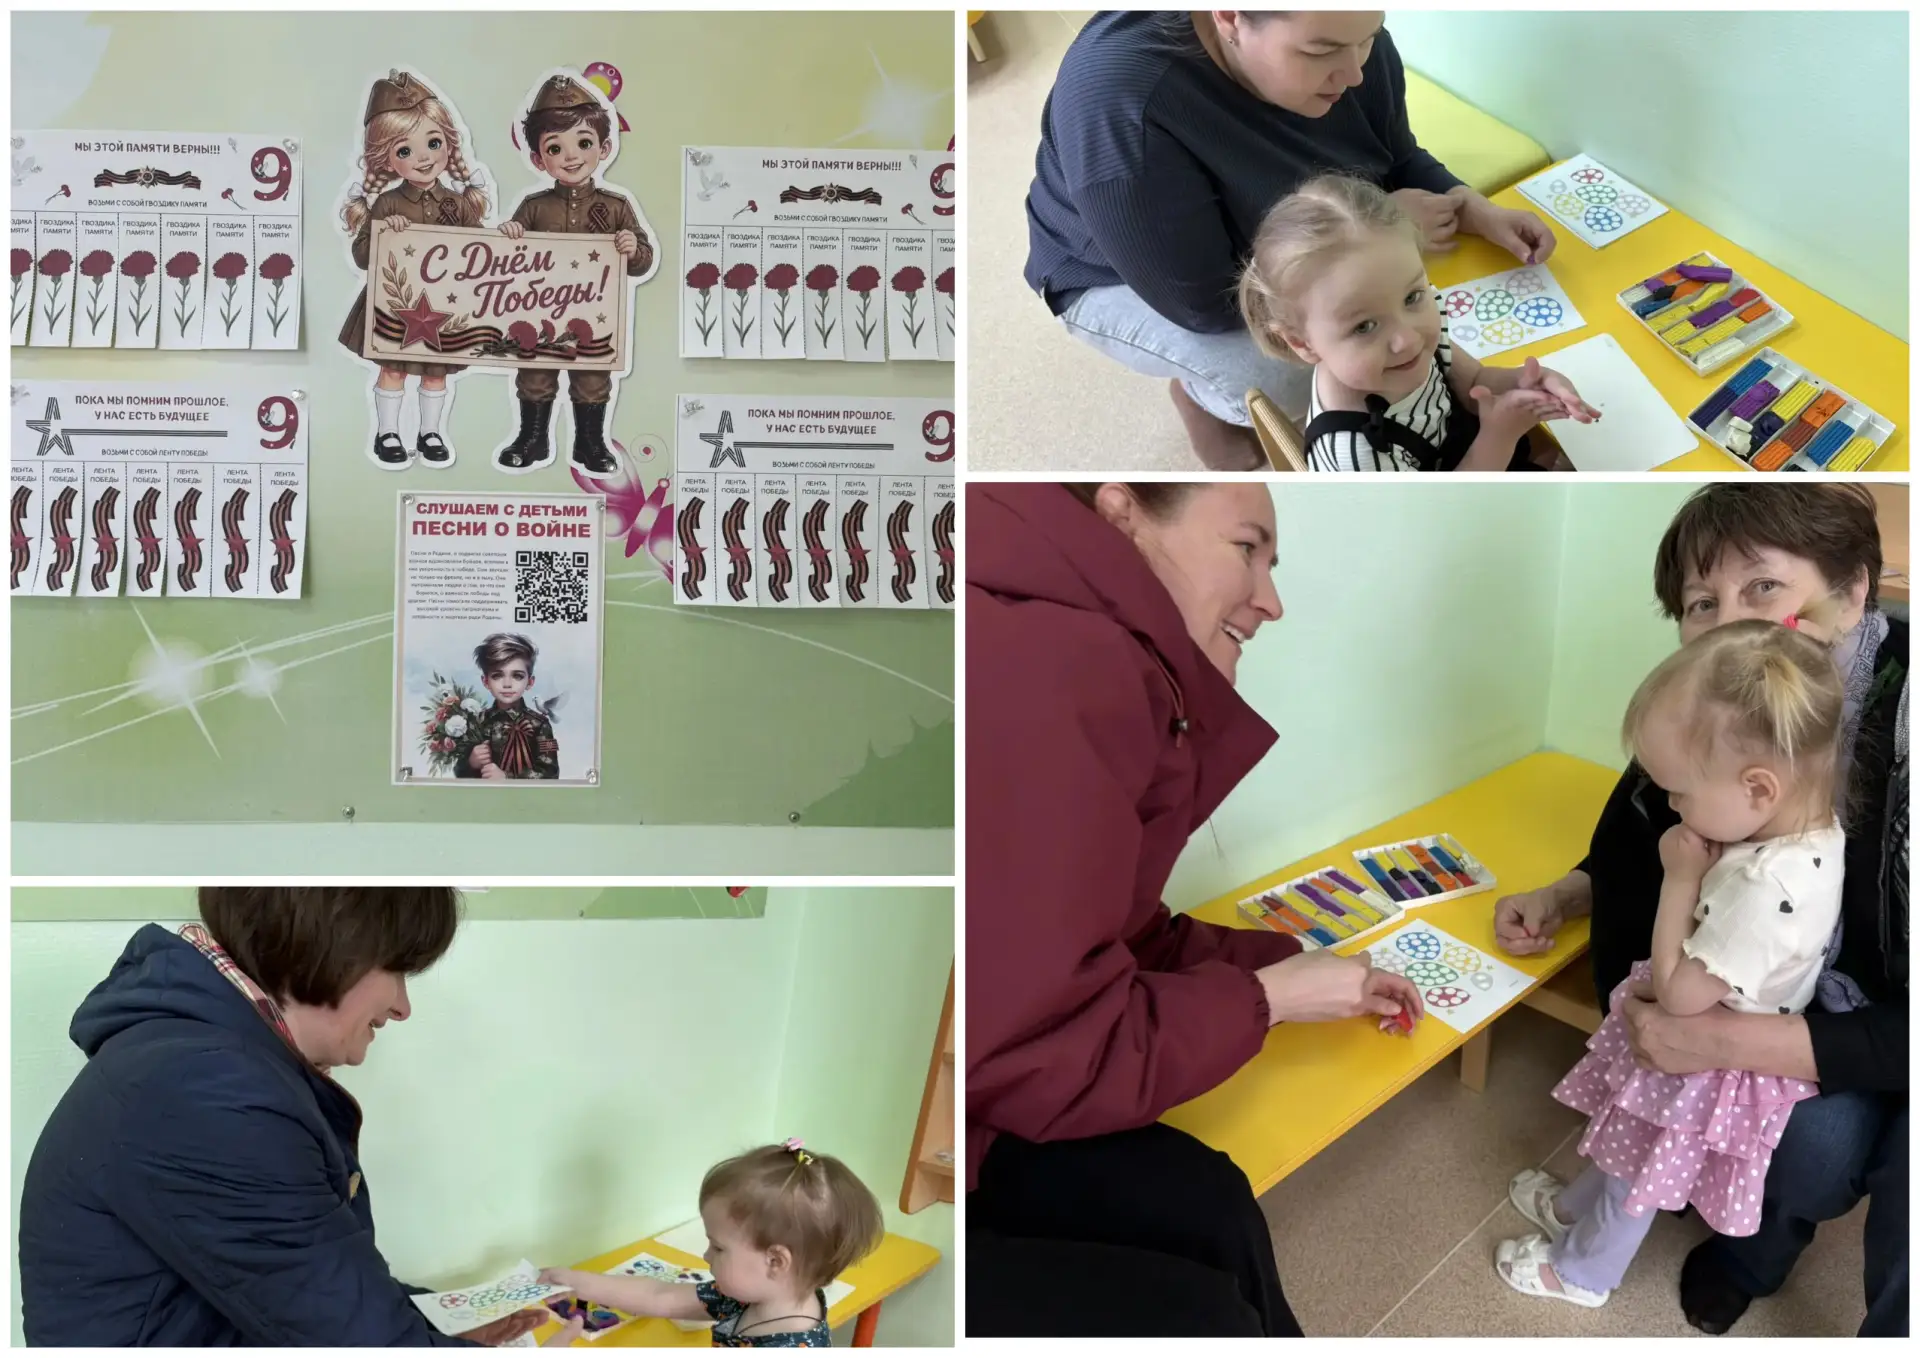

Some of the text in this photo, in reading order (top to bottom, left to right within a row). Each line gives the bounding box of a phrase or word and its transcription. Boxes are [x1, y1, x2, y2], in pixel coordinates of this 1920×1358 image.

[75, 140, 220, 155] МЫ ЭТОЙ ПАМЯТИ ВЕРНЫ!!!
[762, 158, 902, 172] МЫ ЭТОЙ ПАМЯТИ ВЕРНЫ!!!
[250, 146, 292, 201] 9
[88, 199, 115, 207] ВОЗЬМИ
[122, 198, 145, 207] СОБОЙ
[145, 200, 179, 208] ГВОЗДИКУ
[774, 214, 800, 222] ВОЗЬМИ
[806, 213, 828, 222] СОБОЙ
[828, 215, 861, 223] ГВОЗДИКУ
[419, 241, 555, 284] С Днём
[472, 265, 611, 320] Победы!
[75, 395, 229, 407] ПОКА МЫ ПОМНИМ ПРОШЛОЕ,
[94, 411, 209, 422] У НАС ЕСТЬ БУДУЩЕЕ
[257, 395, 299, 449] 9
[748, 409, 896, 421] ПОКА МЫ ПОМНИМ ПРОШЛОЕ,
[766, 424, 877, 436] У НАС ЕСТЬ БУДУЩЕЕ
[922, 409, 955, 462] 9
[135, 448, 158, 456] СОБОЙ
[159, 449, 179, 457] ЛЕНТУ
[805, 460, 827, 469] СОБОЙ
[416, 502, 587, 518] СЛУШАЕМ С ДЕТЬМИ
[412, 520, 591, 538] ПЕСНИ О ВОЙНЕ
